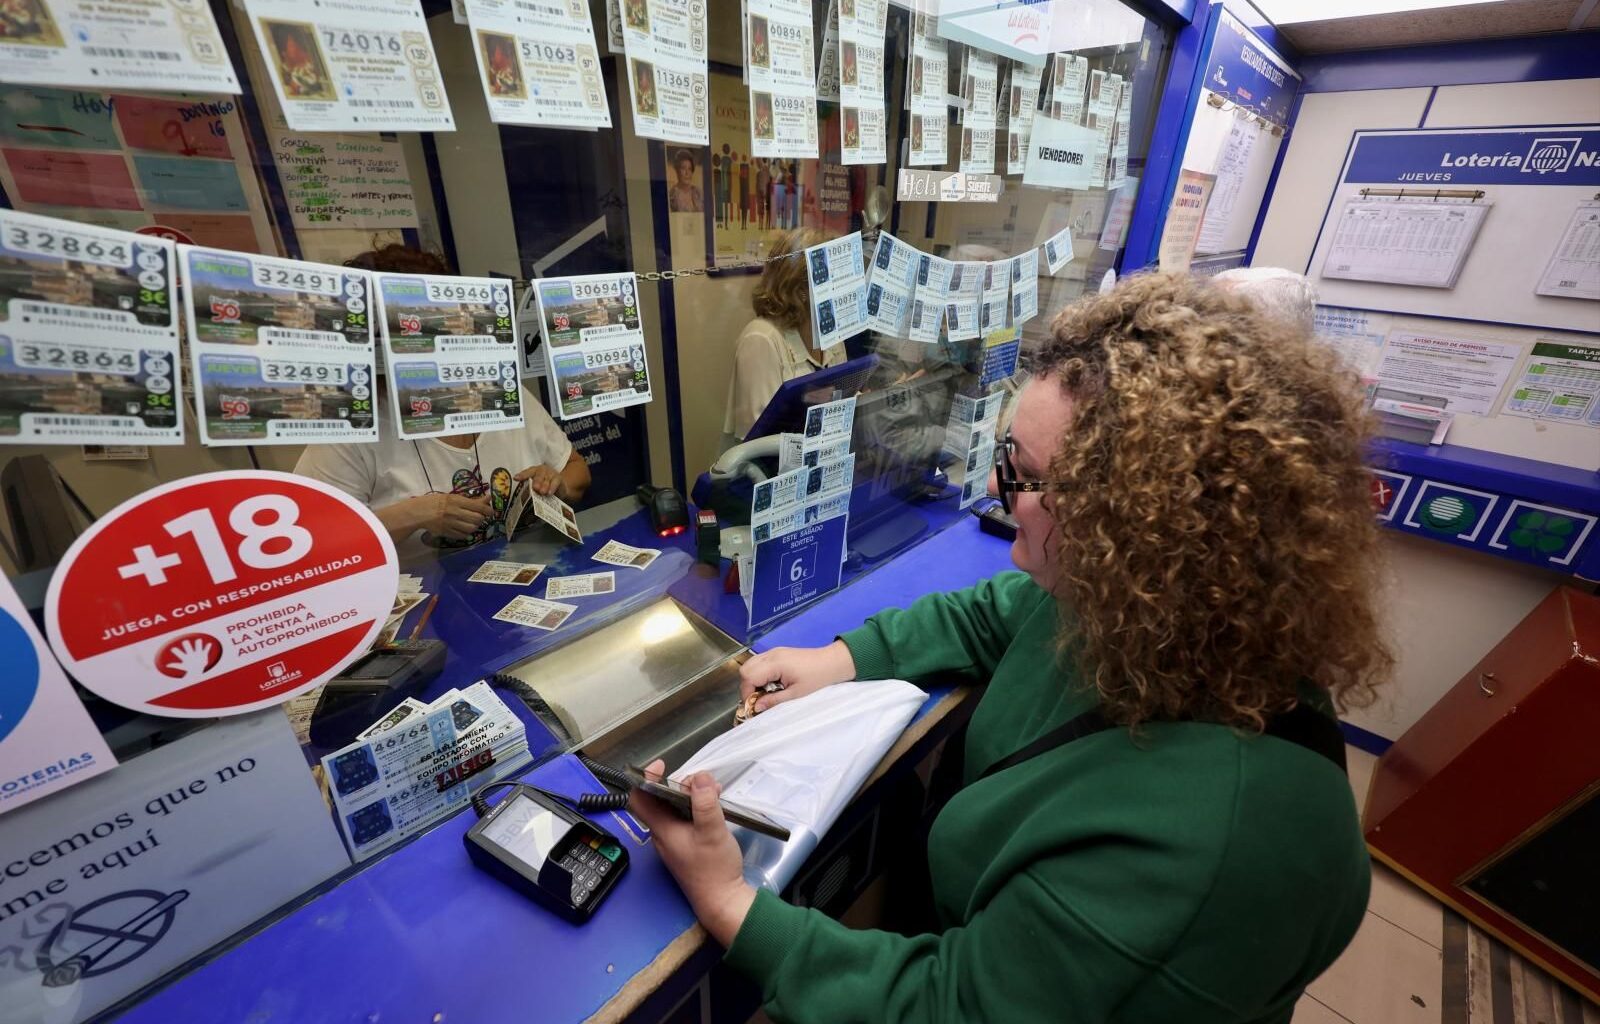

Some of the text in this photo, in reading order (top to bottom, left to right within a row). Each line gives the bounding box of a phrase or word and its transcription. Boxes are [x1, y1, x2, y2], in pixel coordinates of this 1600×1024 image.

[770, 24, 801, 40] 60894
[322, 31, 401, 52] 74016
[521, 42, 576, 62] 51063
[656, 69, 690, 88] 11365
[72, 92, 113, 120] HOY
[177, 101, 234, 122] DOMINGO
[774, 97, 806, 110] 60894
[208, 120, 226, 137] 16
[1039, 146, 1084, 166] VENDEDORES
[1440, 151, 1523, 168] Lotería
[1397, 172, 1452, 182] JUEVES
[967, 181, 992, 193] SUERTE
[10, 227, 128, 262] 32864
[828, 242, 853, 257] 10079
[258, 267, 337, 291] 32491
[139, 289, 167, 305] 3€
[431, 285, 490, 299] 36946
[575, 282, 619, 297] 30694
[833, 291, 858, 308] 10079
[210, 303, 242, 323] 50
[346, 313, 366, 325] 3€
[625, 307, 636, 316] 3€
[400, 319, 422, 336] 50
[496, 317, 511, 327] 3€
[553, 315, 571, 332] 50
[1459, 342, 1488, 351] PREMIOS
[22, 345, 136, 369] 32864
[586, 349, 630, 366] 30694
[266, 364, 343, 381] 32491
[442, 365, 498, 379] 36946
[634, 371, 646, 381] 3€
[147, 393, 172, 407] 3€
[504, 391, 518, 402] 3€
[566, 385, 583, 400] 50
[221, 401, 250, 420] 50
[352, 400, 371, 411] 3€
[411, 400, 432, 417] 50
[606, 427, 623, 440] del
[772, 474, 799, 490] 31709
[770, 515, 796, 531] 31709
[117, 493, 314, 587] +18
[782, 533, 799, 545] ESTE
[790, 535, 815, 549] SORTEO
[101, 554, 363, 641] JUEGA CON RESPONSABILIDAD
[773, 598, 794, 613] Lotería
[226, 602, 308, 635] PROHIBIDA
[231, 611, 316, 646] LA VENTA A
[237, 607, 360, 657] AUTOPROHIBIDOS
[259, 669, 303, 691] LOTERÍAS
[375, 723, 430, 752] 46764
[420, 721, 495, 763] ESTABLECIMIENTO
[433, 732, 488, 766] DOTADO CON
[0, 752, 93, 796] OTERÍAS
[416, 761, 449, 781] EQUIPO
[145, 779, 209, 816] que
[214, 756, 257, 785] no
[79, 828, 162, 880] aquí
